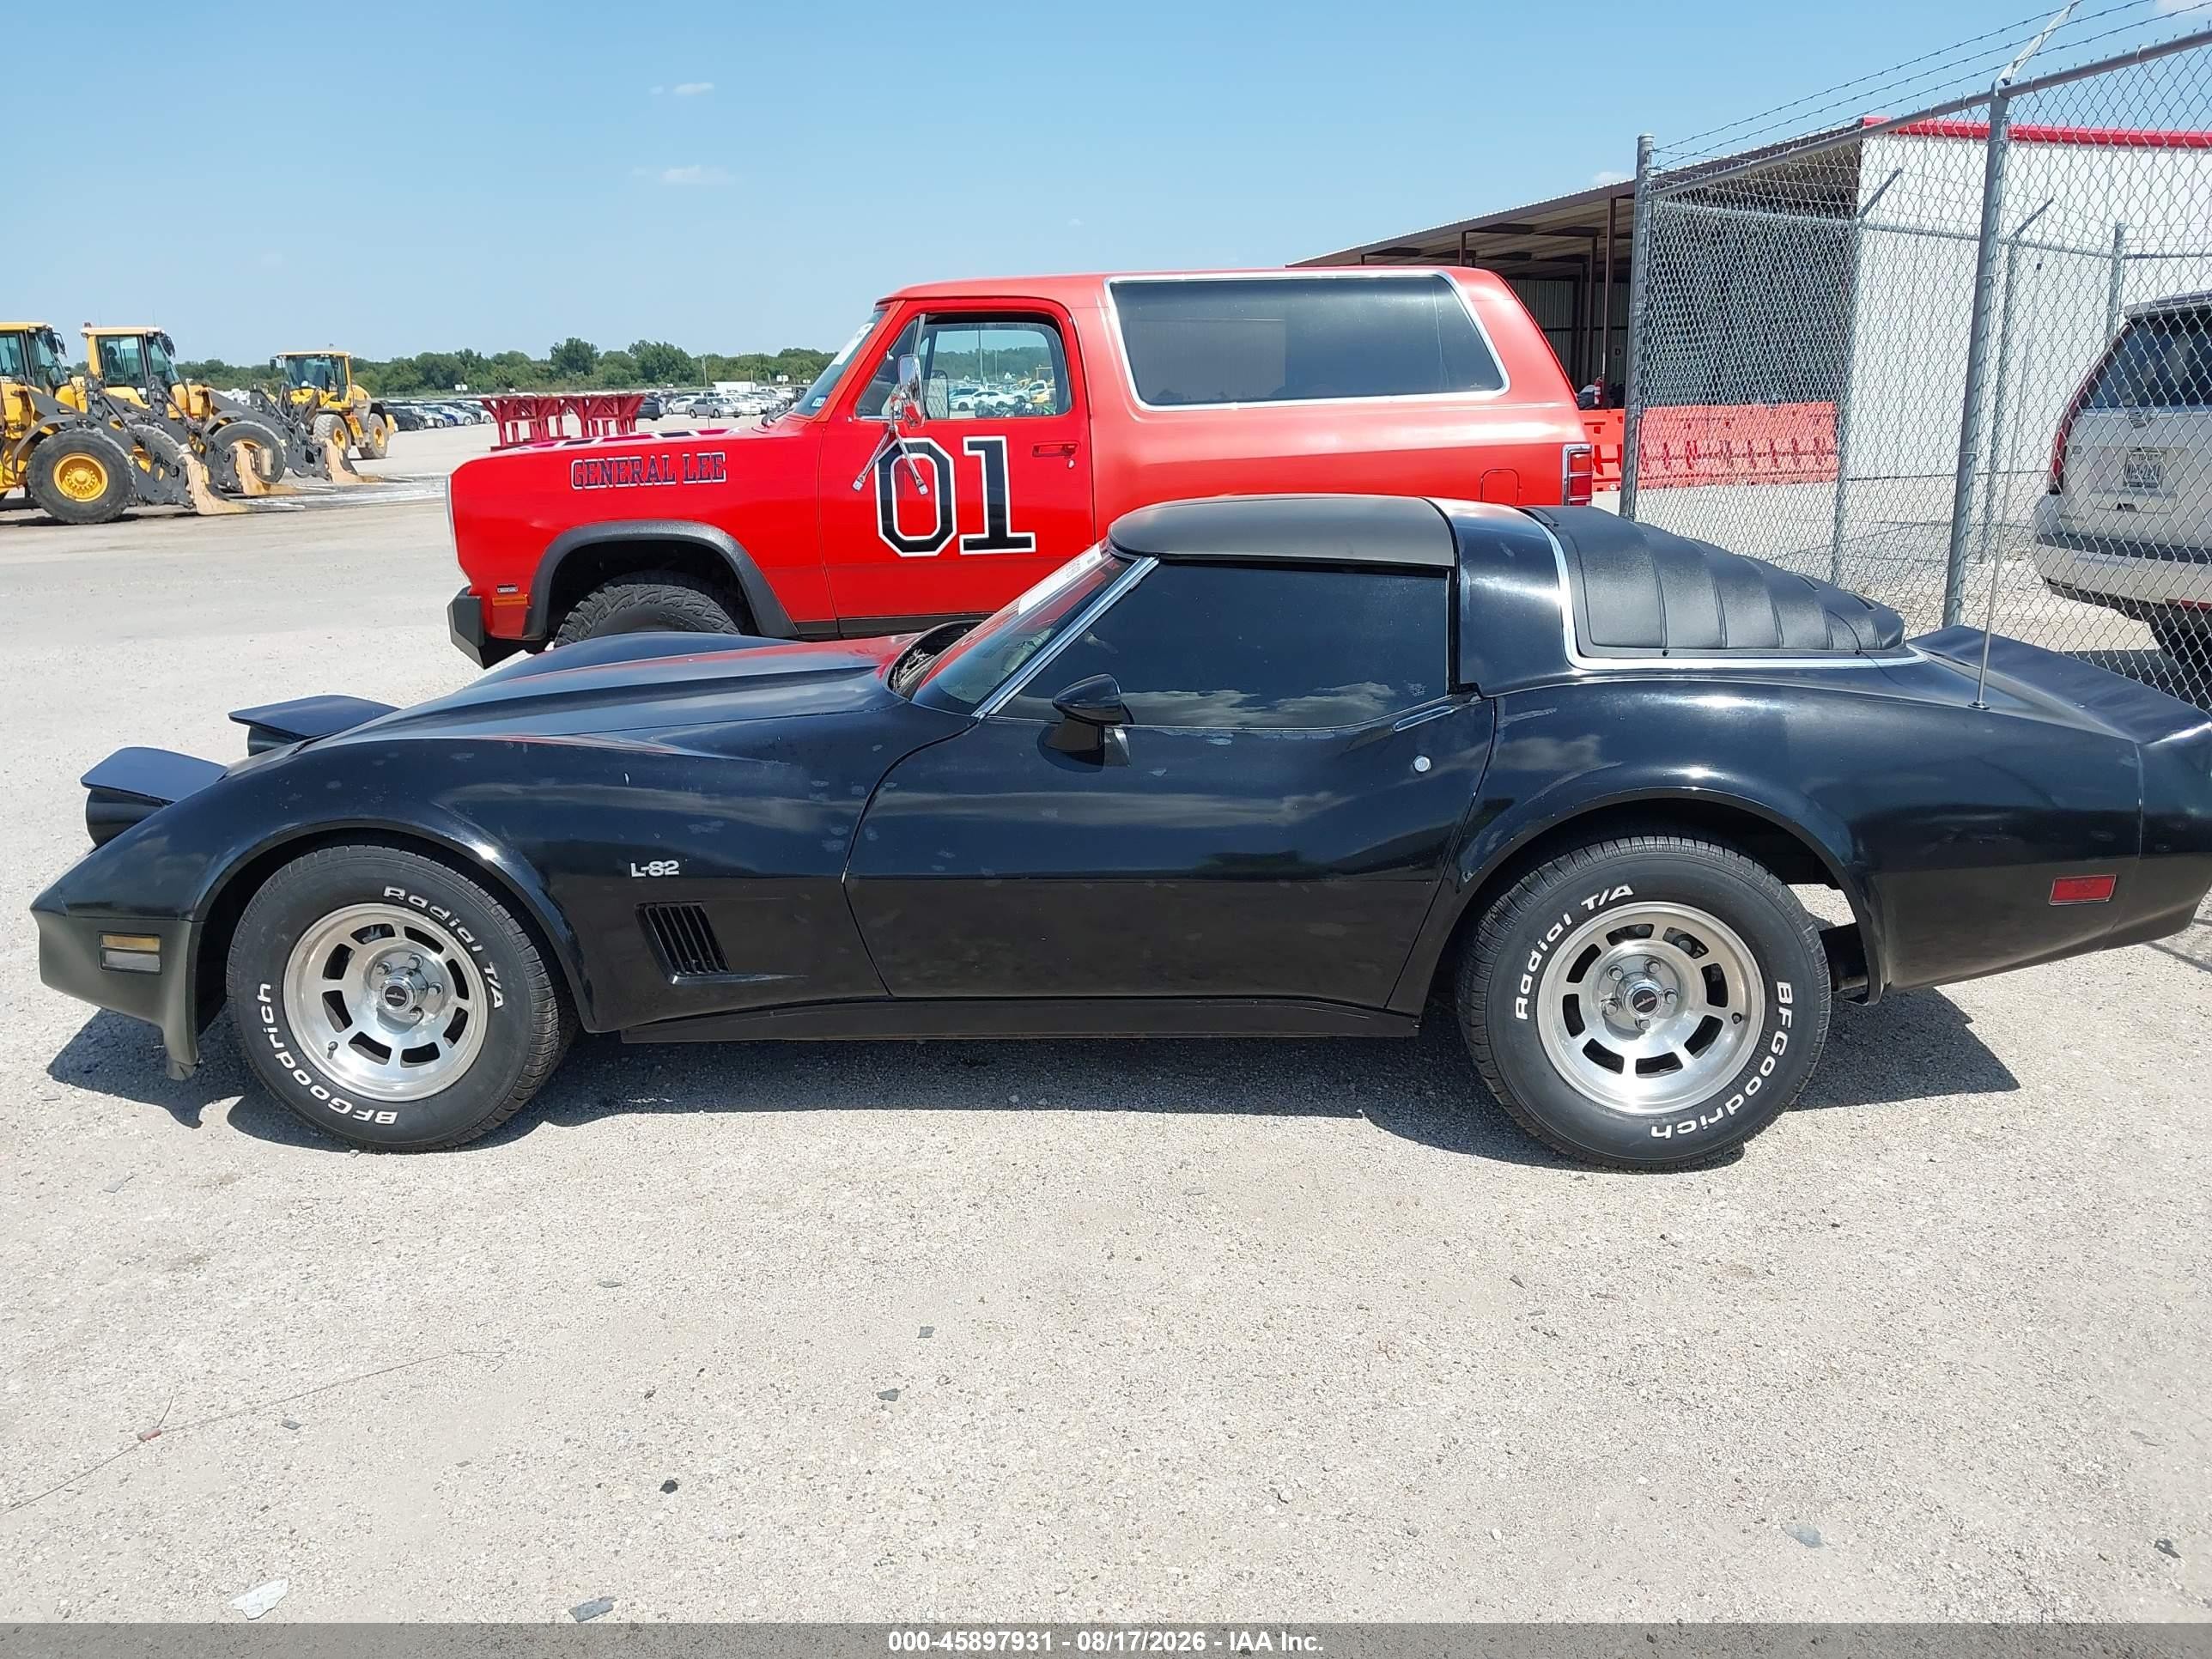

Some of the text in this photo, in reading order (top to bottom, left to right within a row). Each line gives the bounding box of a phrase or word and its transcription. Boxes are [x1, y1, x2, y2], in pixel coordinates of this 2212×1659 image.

[571, 452, 726, 490] GENERAL LEE
[874, 435, 1036, 557] 01
[630, 860, 680, 878] L-82
[383, 886, 505, 1009] Radial T/A
[1514, 884, 1634, 1020] Radial T/A
[257, 982, 399, 1125] BFGoodrich
[1650, 981, 1793, 1139] BFGoodrich
